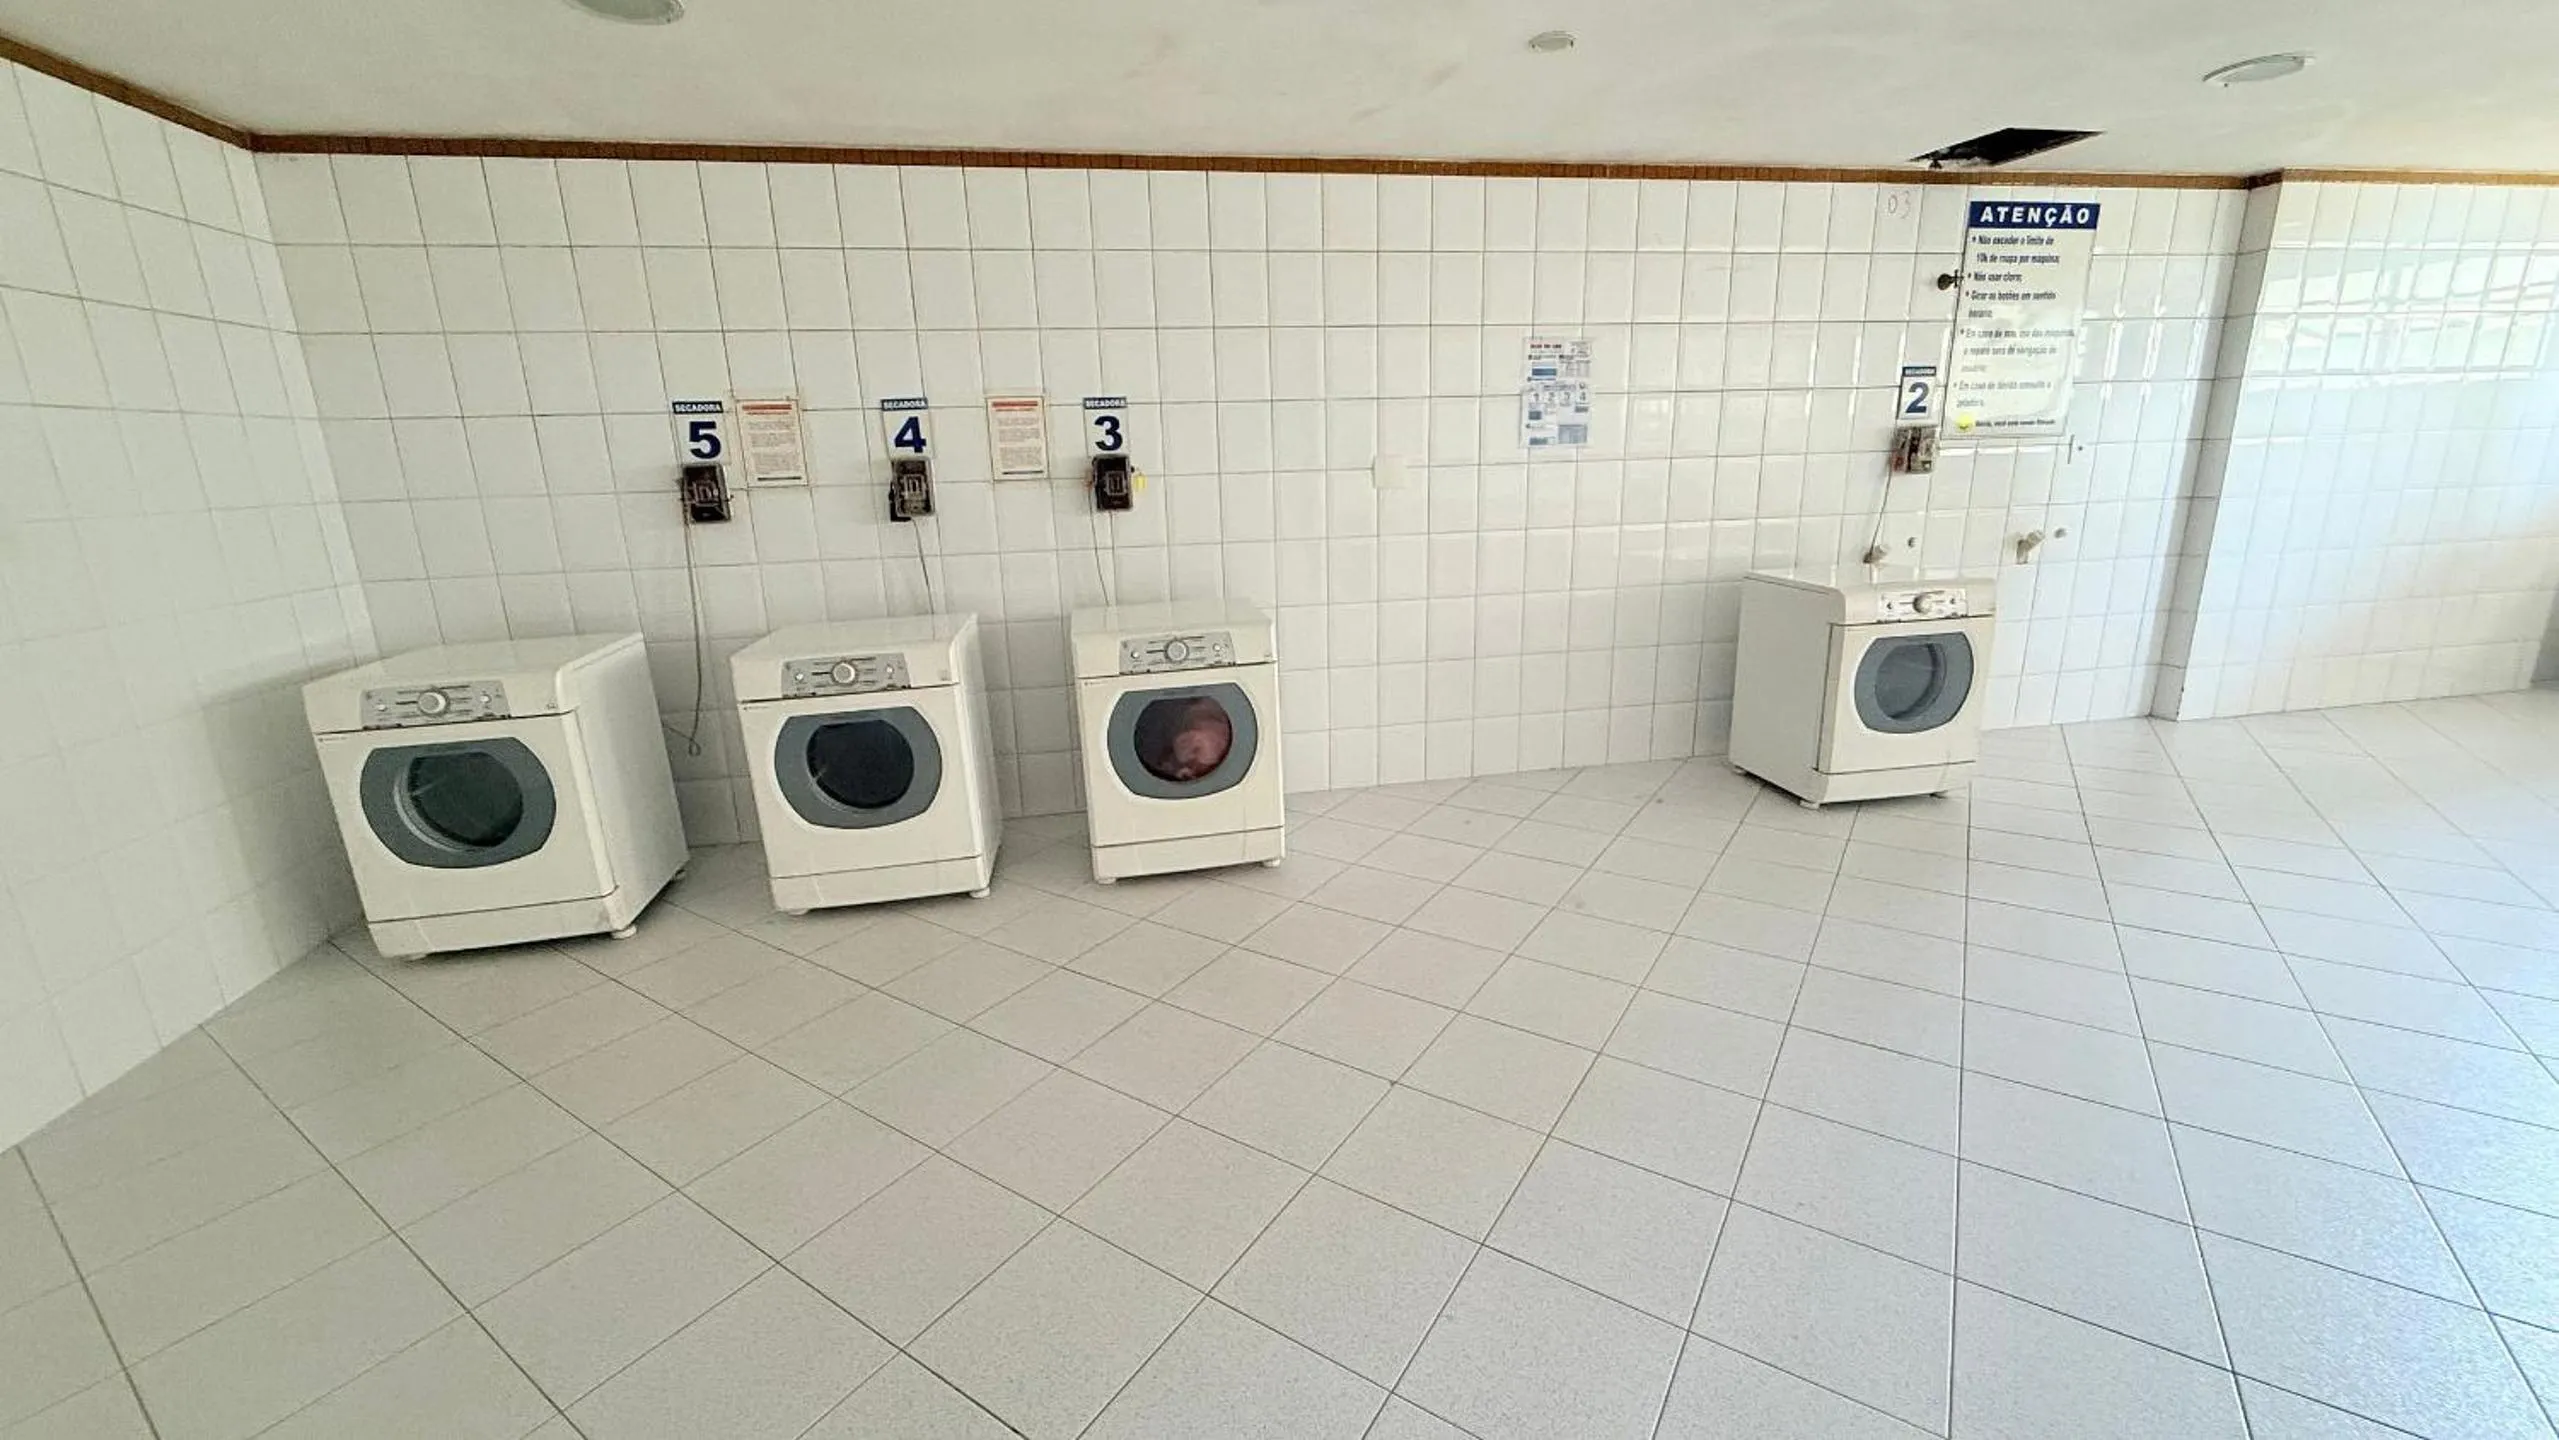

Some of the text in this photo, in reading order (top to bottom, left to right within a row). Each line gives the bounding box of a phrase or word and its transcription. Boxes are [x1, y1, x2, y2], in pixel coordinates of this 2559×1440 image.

[1980, 204, 2090, 228] ATENÇÃO
[2026, 235, 2044, 245] limite
[2045, 235, 2054, 245] de
[1989, 253, 1998, 263] de
[1999, 255, 2017, 265] roupa
[2018, 255, 2029, 266] por
[1988, 274, 2002, 282] usar
[883, 400, 926, 410] SECADORA
[1906, 382, 1929, 413] 2
[674, 402, 721, 412] SECADORA
[689, 421, 722, 459] 5
[894, 416, 927, 453] 4
[1094, 415, 1123, 451] 3
